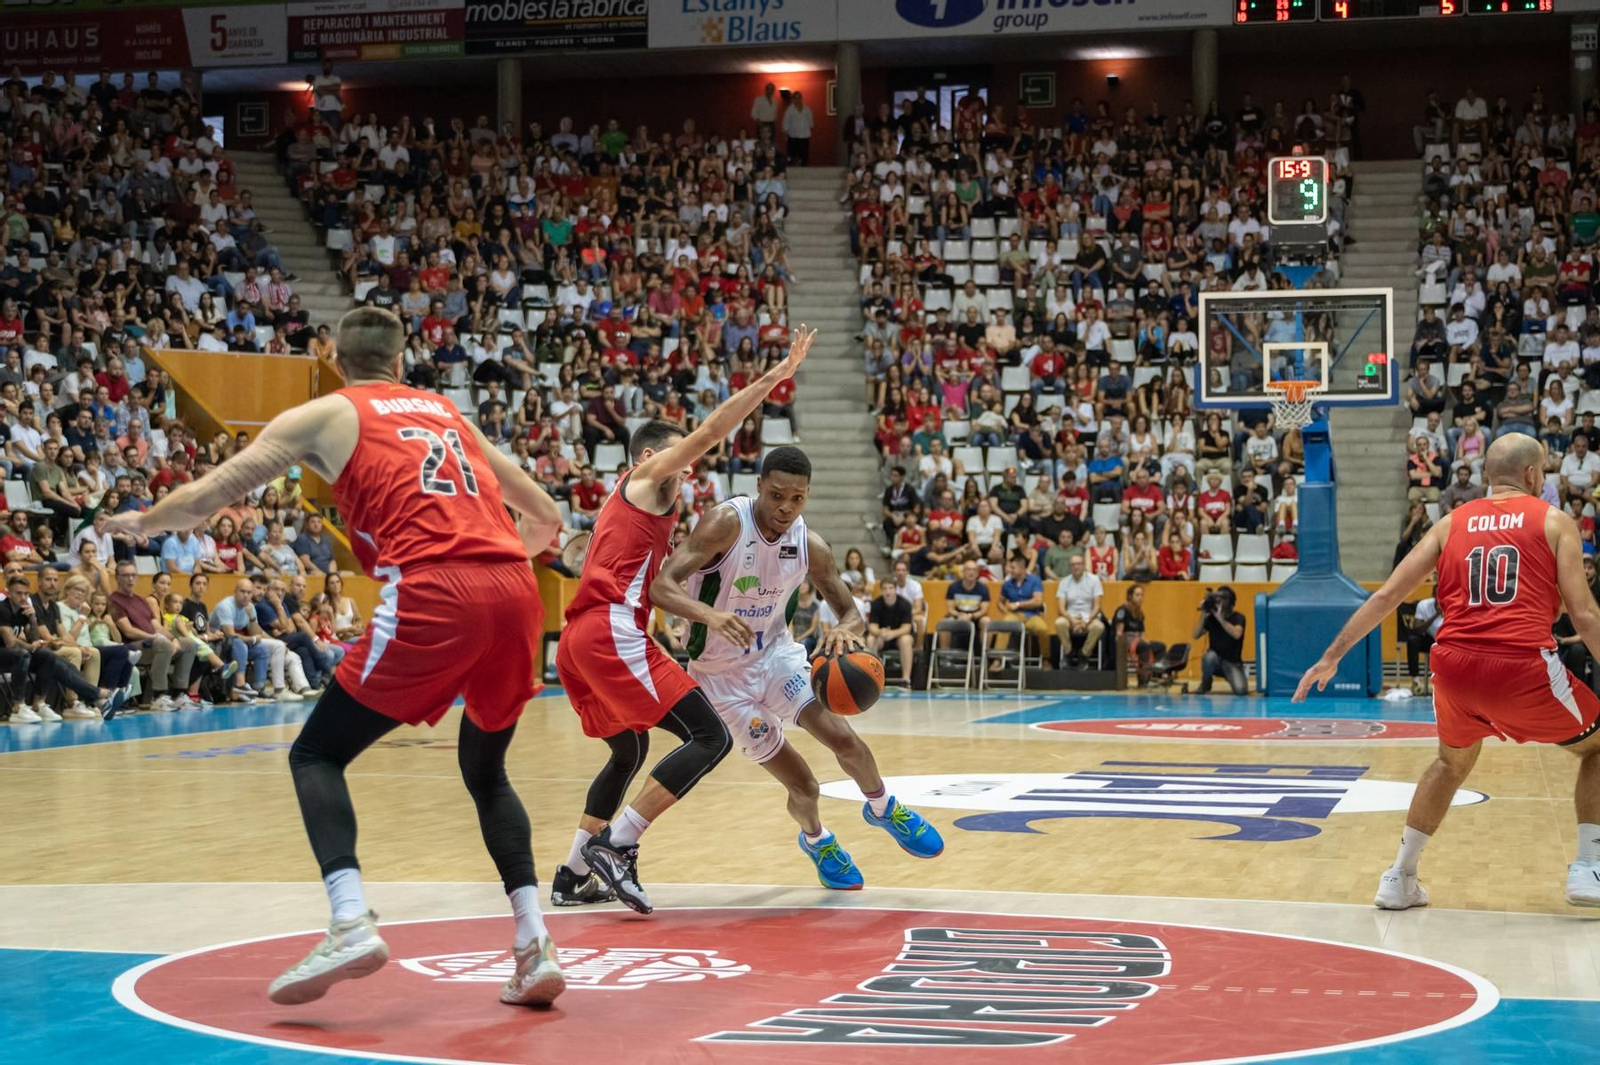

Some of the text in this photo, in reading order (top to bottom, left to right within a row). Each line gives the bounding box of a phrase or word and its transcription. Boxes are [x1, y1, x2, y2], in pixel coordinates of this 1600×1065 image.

[303, 17, 361, 31] REPARACIÓ
[373, 12, 446, 28] MANTENIMENT
[1237, 11, 1247, 22] 10
[1335, 2, 1347, 19] 4
[210, 14, 228, 51] 5
[727, 16, 801, 42] Blaus
[993, 12, 1048, 33] group
[5, 28, 100, 51] UHAUS
[303, 27, 449, 46] DE MAQUINÀRIA INDUSTRIAL
[1279, 160, 1311, 178] 15:9
[1299, 178, 1318, 210] 9
[397, 426, 480, 496] 21
[1467, 511, 1525, 533] COLOM
[1464, 544, 1521, 606] 10
[692, 926, 1172, 1048] GIRONA
